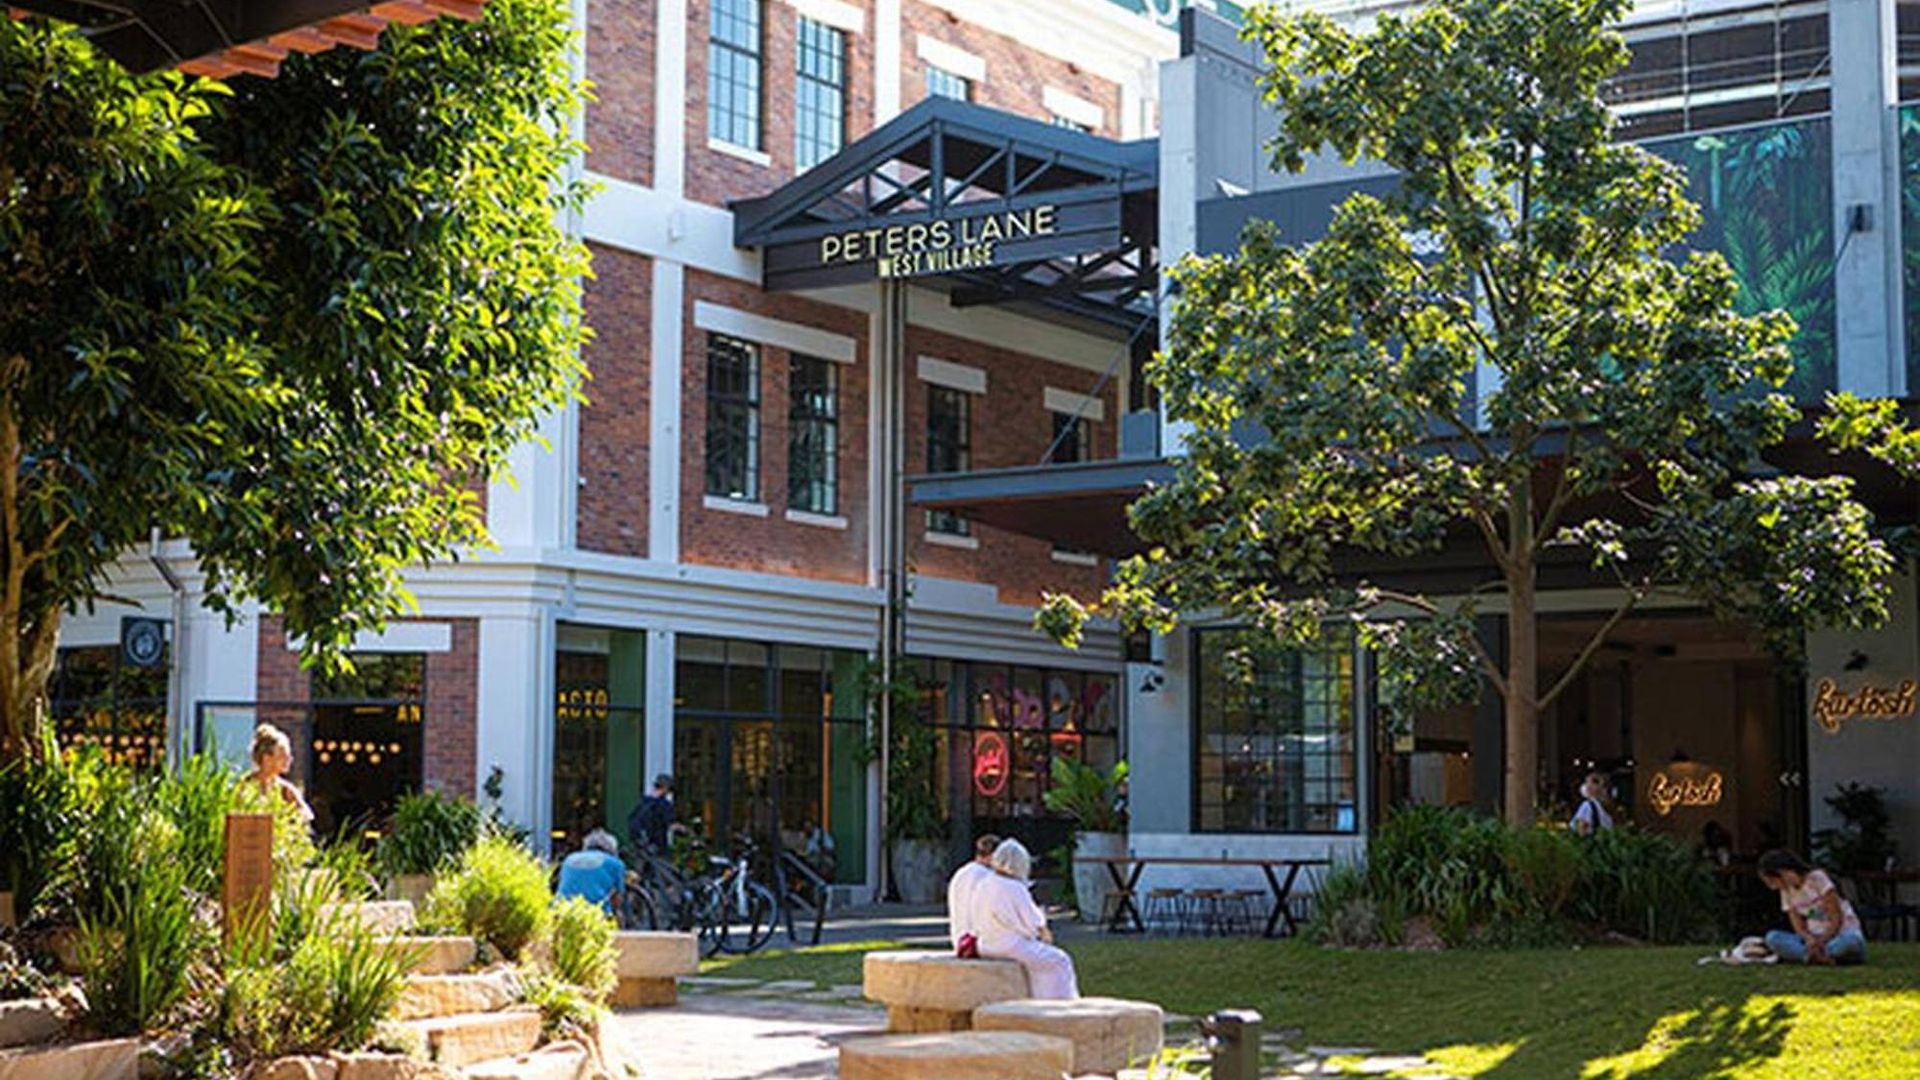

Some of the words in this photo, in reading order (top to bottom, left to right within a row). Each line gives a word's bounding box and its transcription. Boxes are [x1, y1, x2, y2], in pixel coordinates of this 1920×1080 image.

[821, 219, 952, 265] PETERS
[961, 204, 1055, 244] LANE
[878, 252, 919, 277] WEST
[925, 241, 993, 273] VILLAGE
